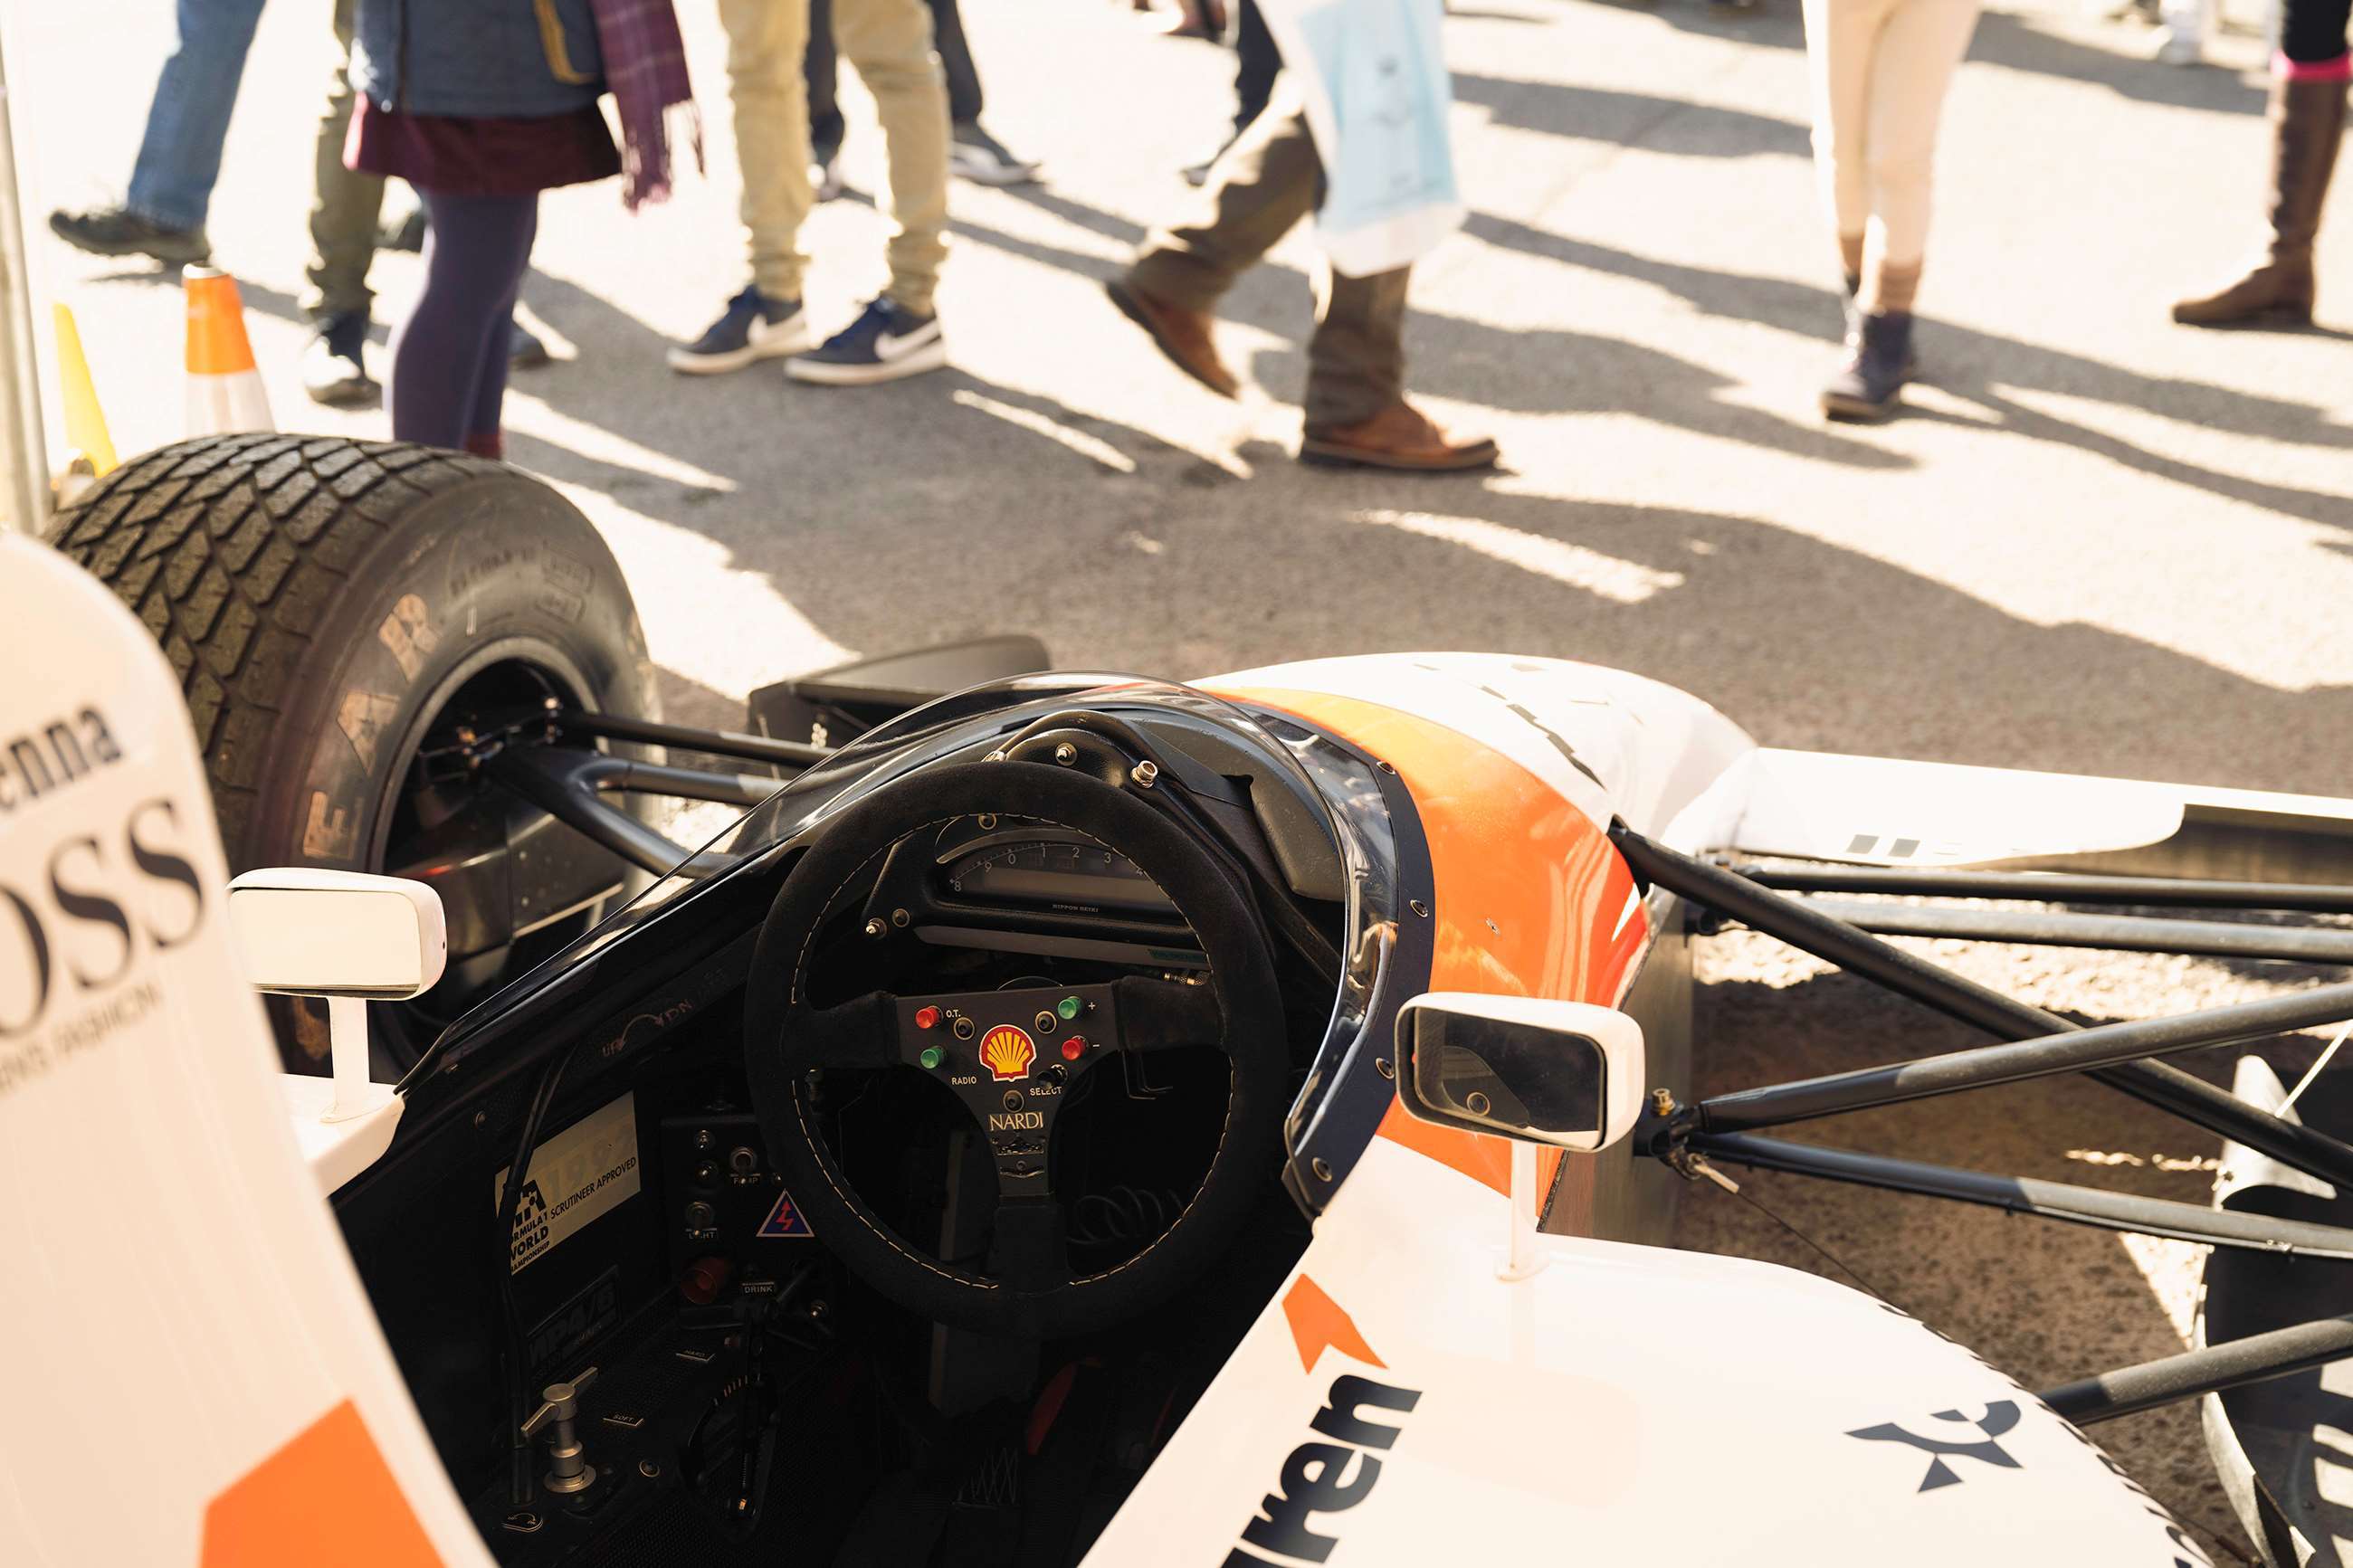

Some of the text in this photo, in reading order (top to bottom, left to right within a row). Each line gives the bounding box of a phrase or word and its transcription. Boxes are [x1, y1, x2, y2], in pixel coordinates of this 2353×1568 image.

[954, 881, 962, 892] 8
[984, 861, 993, 873] 9
[1007, 853, 1016, 865] 0
[1072, 847, 1080, 859] 2
[1103, 852, 1112, 863] 3
[946, 1009, 961, 1018] O.T.
[951, 1076, 977, 1086] RADIO
[989, 1111, 1044, 1132] NARDI
[550, 1156, 637, 1220] SCRUTINEER APPROVED
[744, 1285, 774, 1294] DRINK
[1220, 1374, 1423, 1568] ren
